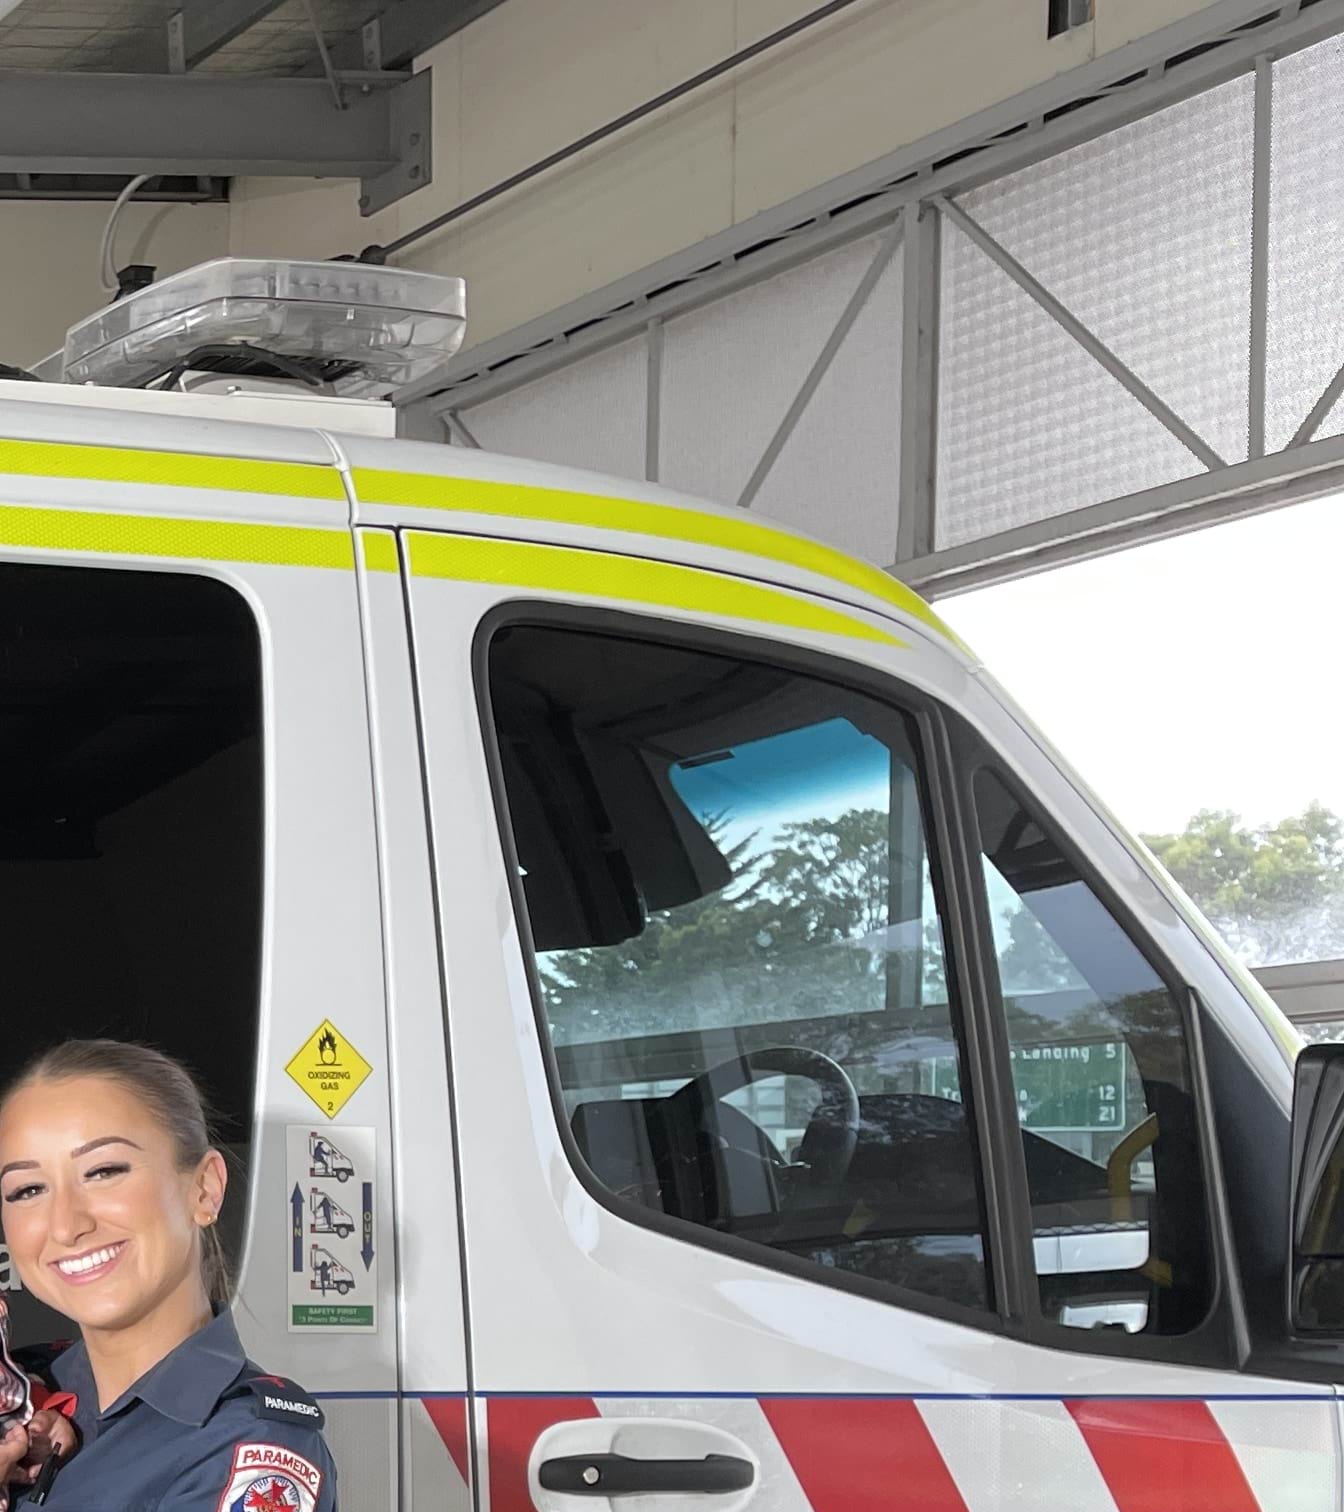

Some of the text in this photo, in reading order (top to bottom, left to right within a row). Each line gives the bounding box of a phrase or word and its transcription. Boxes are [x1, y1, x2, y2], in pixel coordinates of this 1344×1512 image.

[1106, 1044, 1116, 1059] 5
[308, 1072, 351, 1080] OXIDIZING
[320, 1082, 340, 1090] GAS
[1099, 1086, 1115, 1100] 12
[327, 1101, 334, 1111] 2
[1099, 1107, 1115, 1122] 21
[265, 1396, 320, 1418] PARAMEDIC
[242, 1449, 318, 1485] PARAMEDIC
